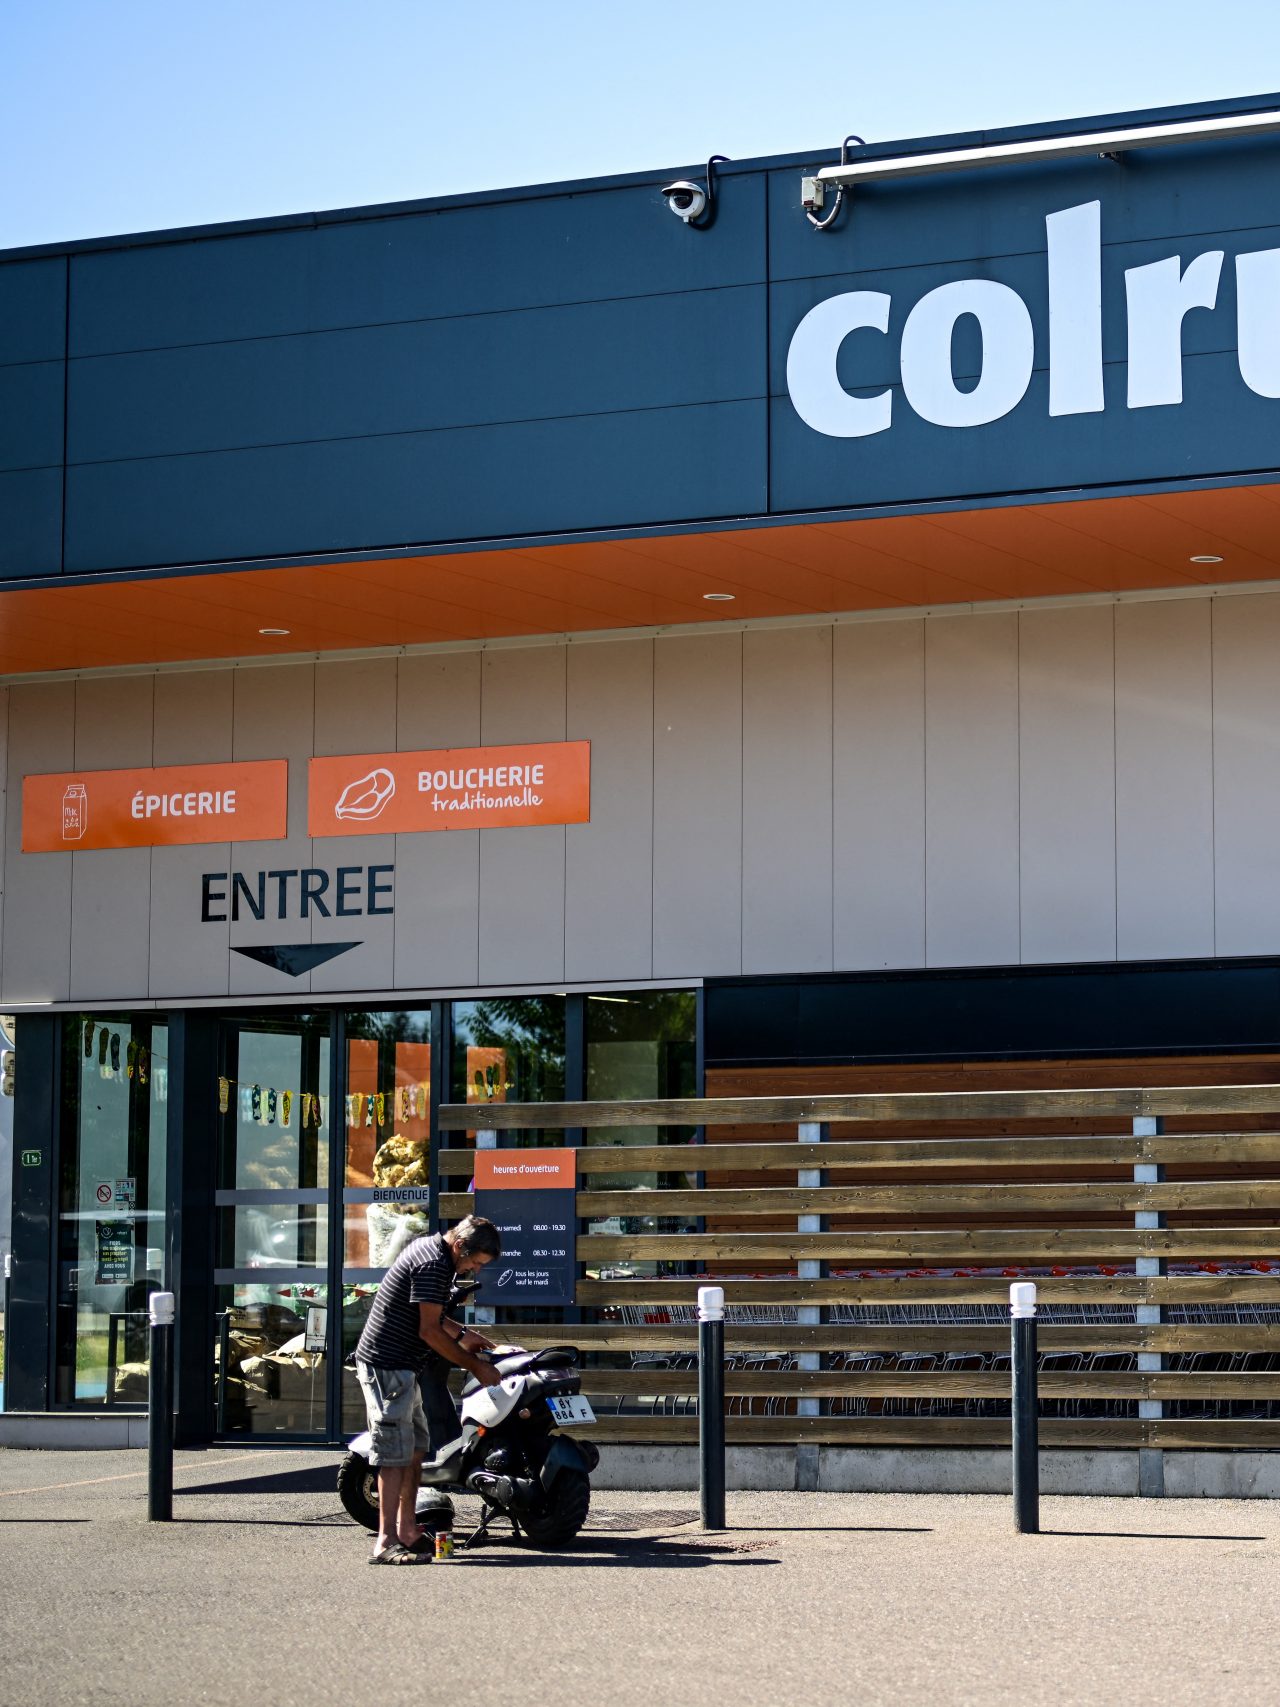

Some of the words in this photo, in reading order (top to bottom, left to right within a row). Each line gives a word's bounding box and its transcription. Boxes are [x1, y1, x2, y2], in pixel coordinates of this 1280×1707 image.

[418, 764, 544, 792] BOUCHERIE
[131, 790, 236, 819] ÉPICERIE
[431, 787, 543, 812] traditionnelle
[201, 864, 394, 923] ENTREE
[493, 1165, 517, 1174] heures
[519, 1165, 560, 1173] d'ouverture
[373, 1190, 428, 1200] BIENVENUE
[536, 1270, 550, 1278] jours
[554, 1410, 574, 1420] 884
[580, 1408, 587, 1418] F
